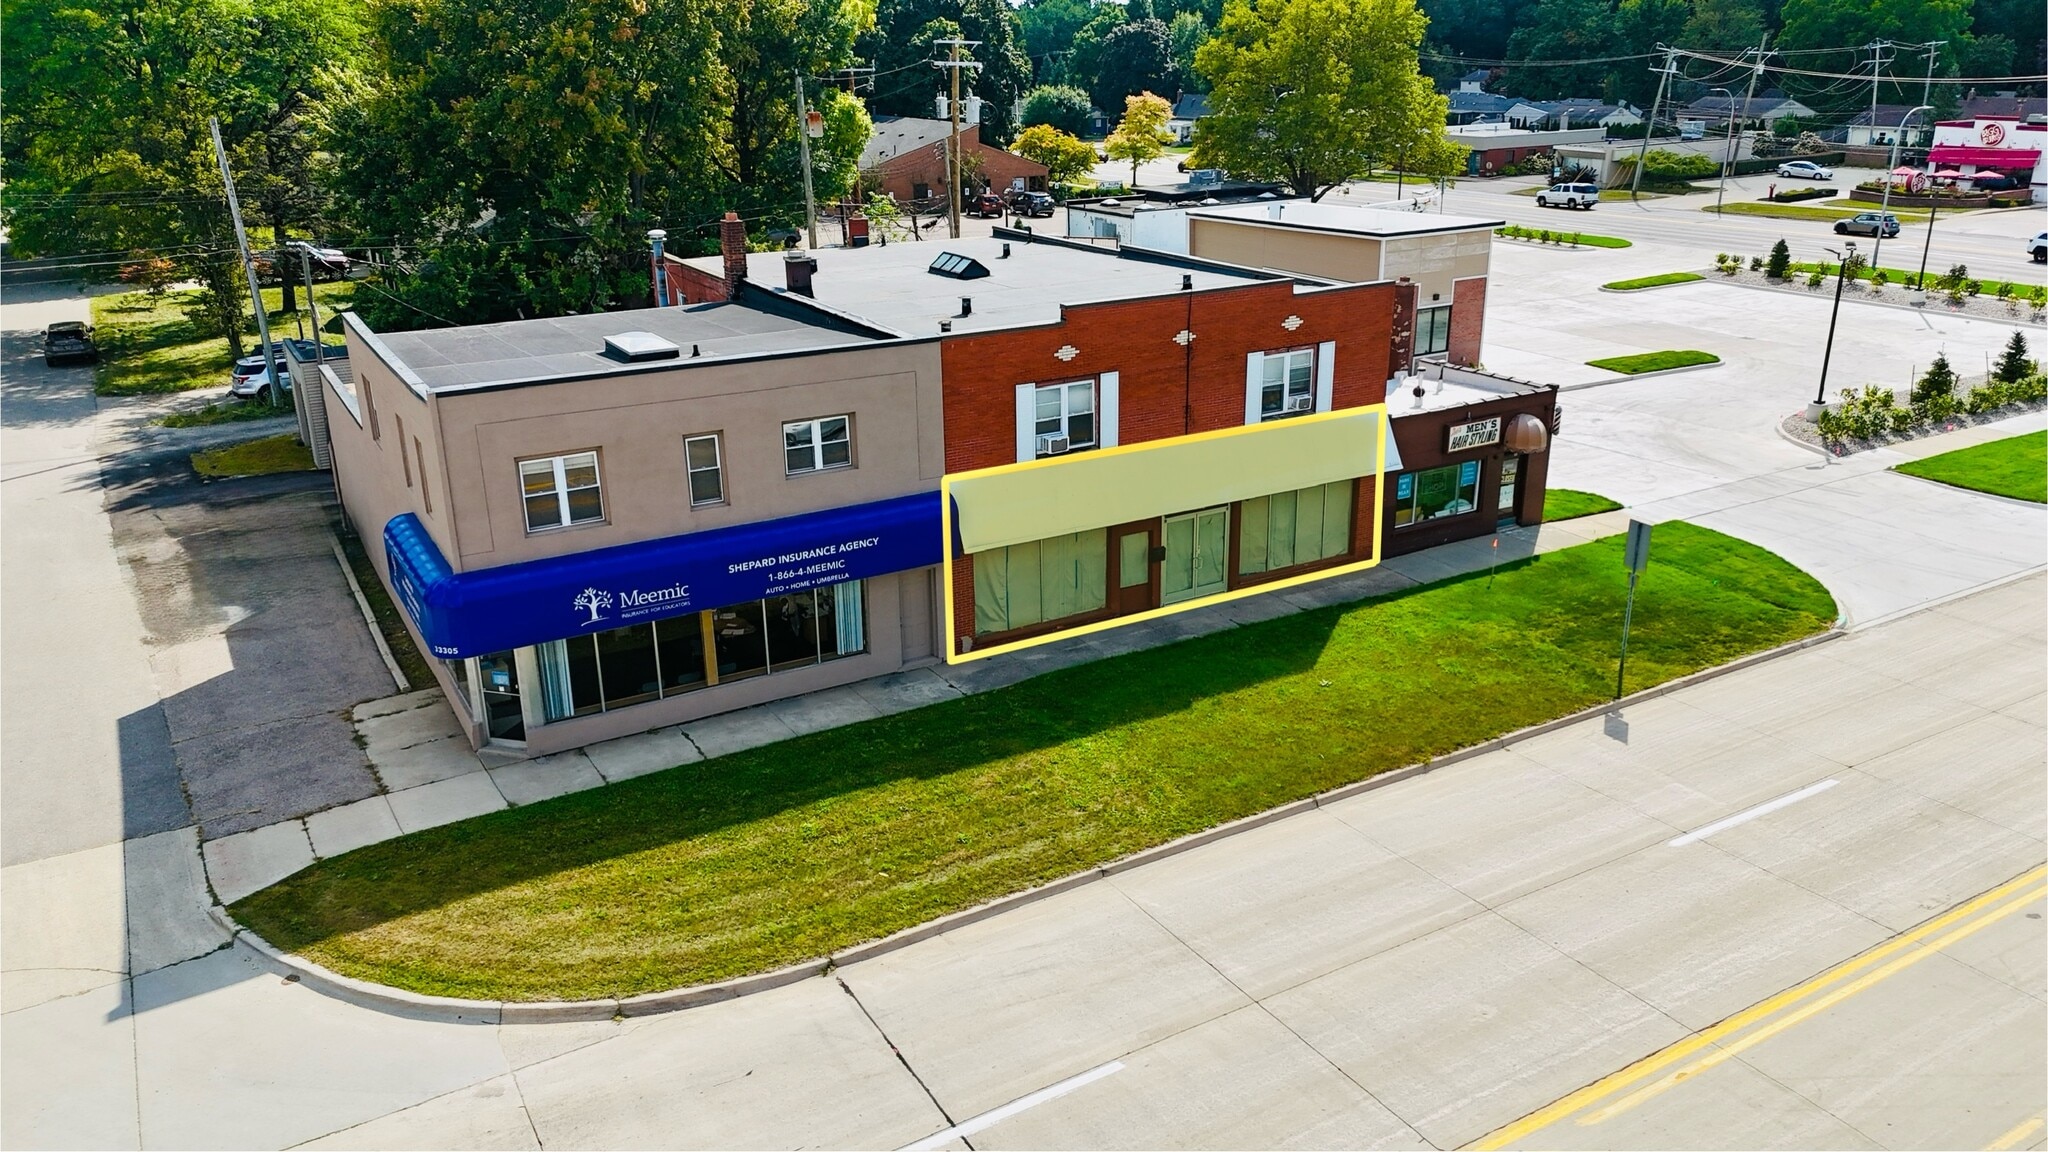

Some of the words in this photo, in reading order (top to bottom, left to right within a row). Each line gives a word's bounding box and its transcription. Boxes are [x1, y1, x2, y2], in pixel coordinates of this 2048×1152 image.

[1466, 420, 1497, 433] MEN'S
[1450, 434, 1470, 450] HAIR
[1469, 429, 1499, 447] STYLING
[728, 557, 776, 574] SHEPARD
[778, 545, 836, 564] INSURANCE
[839, 537, 879, 553] AGENCY
[768, 559, 846, 582] 1-866-4-MEEMIC
[765, 585, 784, 594] AUTO
[790, 580, 811, 590] HOME
[816, 572, 850, 584] UMBRELLA
[619, 582, 690, 608] Meemic
[621, 608, 649, 619] INSURANCE
[662, 600, 691, 611] EDUCATORS
